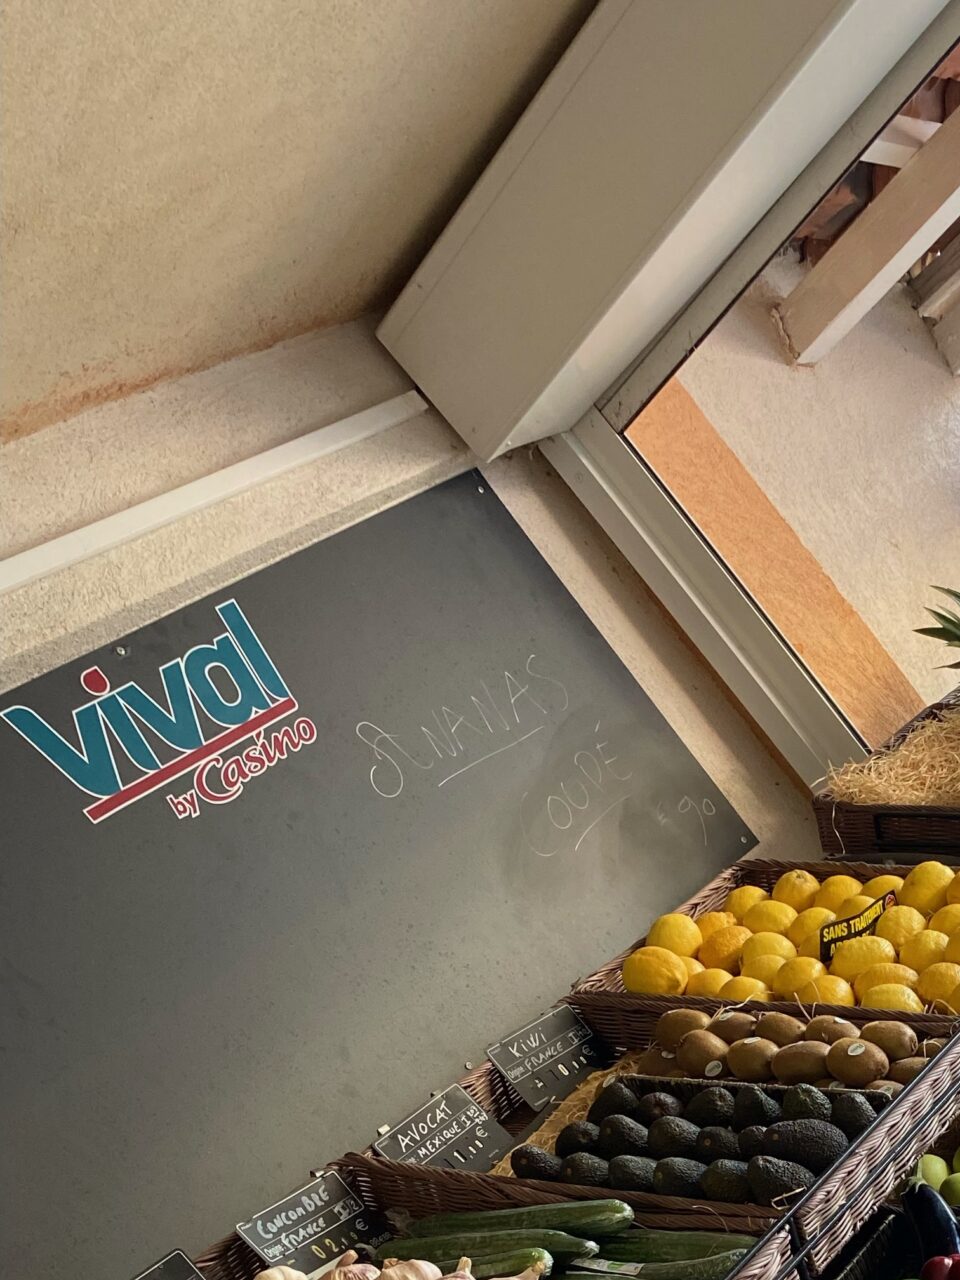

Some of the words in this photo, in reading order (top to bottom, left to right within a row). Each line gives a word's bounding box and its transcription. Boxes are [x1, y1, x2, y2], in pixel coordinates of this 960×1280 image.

[356, 654, 570, 799] ANANAS
[166, 788, 201, 820] by
[193, 717, 318, 805] Casino
[823, 922, 848, 942] SANS
[524, 1041, 565, 1072] FRANCE
[396, 1099, 453, 1154] AVOCAT
[475, 1126, 488, 1139] €
[280, 1216, 327, 1251] FRANCE
[355, 1217, 370, 1232] €
